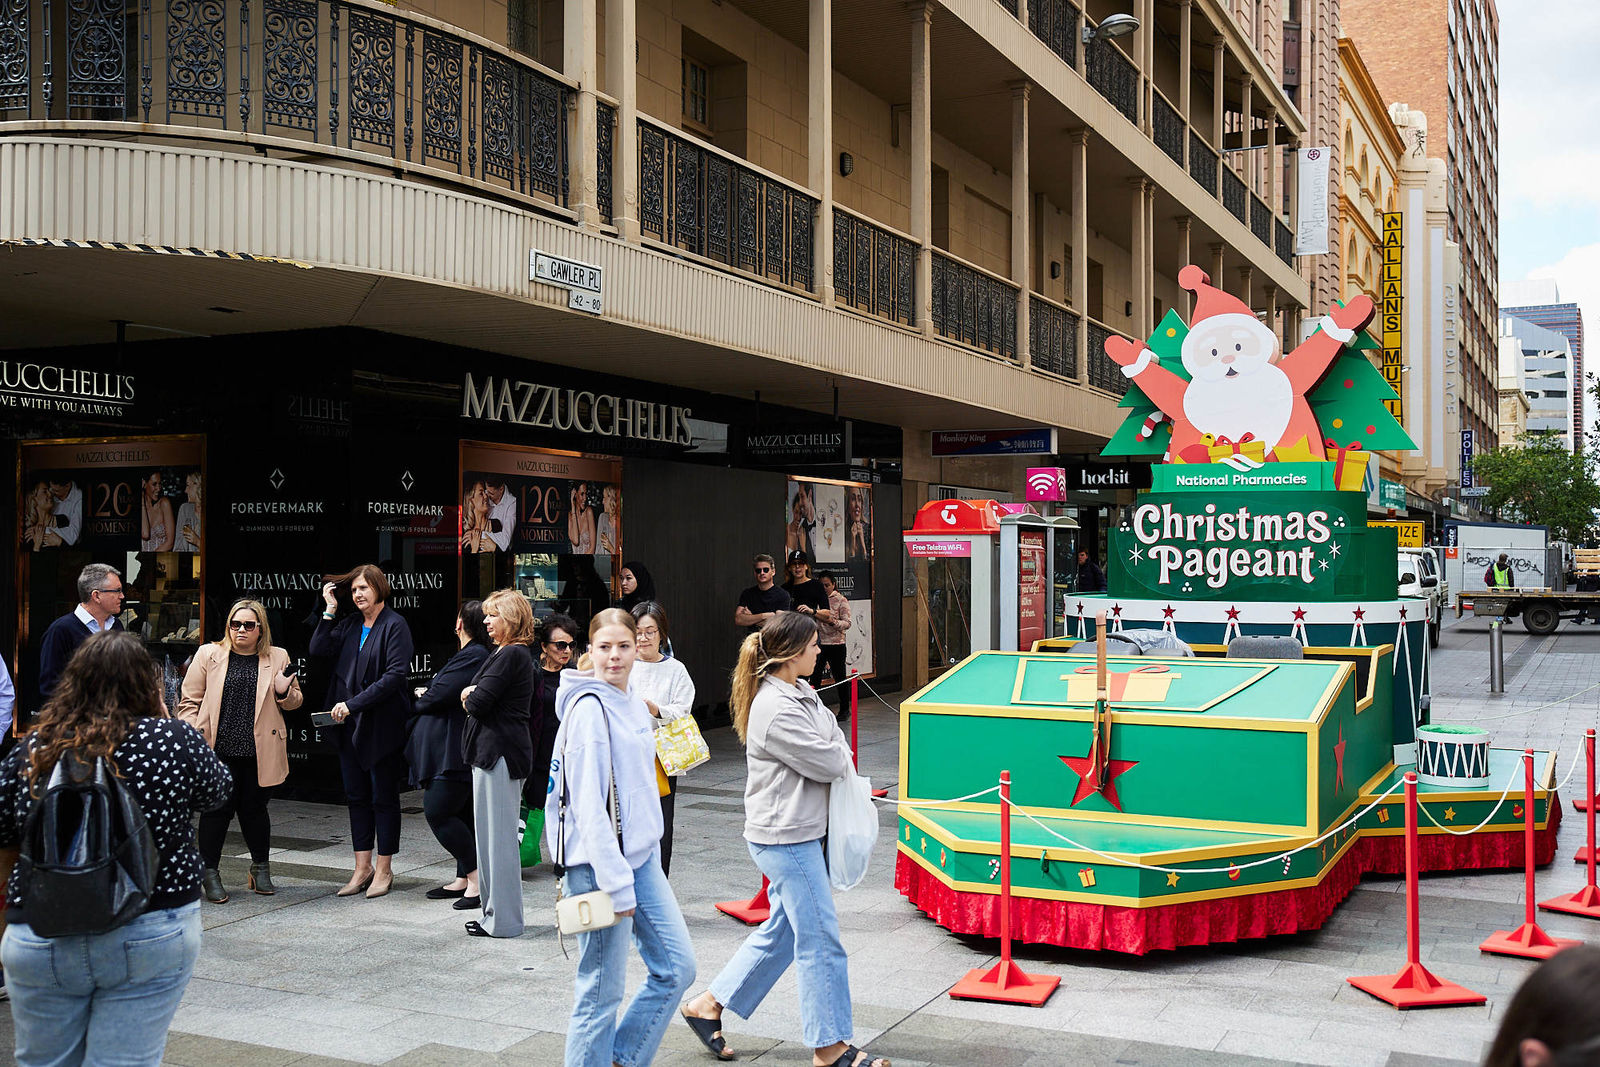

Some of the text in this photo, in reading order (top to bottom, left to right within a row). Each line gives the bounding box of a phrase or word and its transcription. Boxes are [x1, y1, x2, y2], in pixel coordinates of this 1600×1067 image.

[550, 261, 599, 288] GAWLER PL
[1384, 231, 1400, 331] ALLANS
[574, 295, 583, 306] 42
[592, 299, 601, 310] 80
[0, 360, 135, 400] UCCHELLI'S
[20, 397, 51, 410] WITH
[55, 401, 77, 412] YOU
[80, 404, 123, 417] ALWAYS
[460, 371, 692, 446] MAZZUCCHELLI'S
[747, 433, 841, 447] MAZZUCCHELLI'S
[940, 433, 986, 443] Monkey King
[1081, 468, 1131, 486] hockit
[1176, 473, 1307, 486] National Pharmacies
[231, 502, 323, 514] FOREVERMARK
[368, 501, 444, 516] FOREVERMARK
[1133, 503, 1331, 544] Christmas
[520, 527, 564, 542] MOMENTS
[1147, 545, 1315, 589] Pageant
[261, 596, 292, 609] LOVE
[393, 596, 420, 609] LOVE
[288, 752, 308, 760] LWAYS
